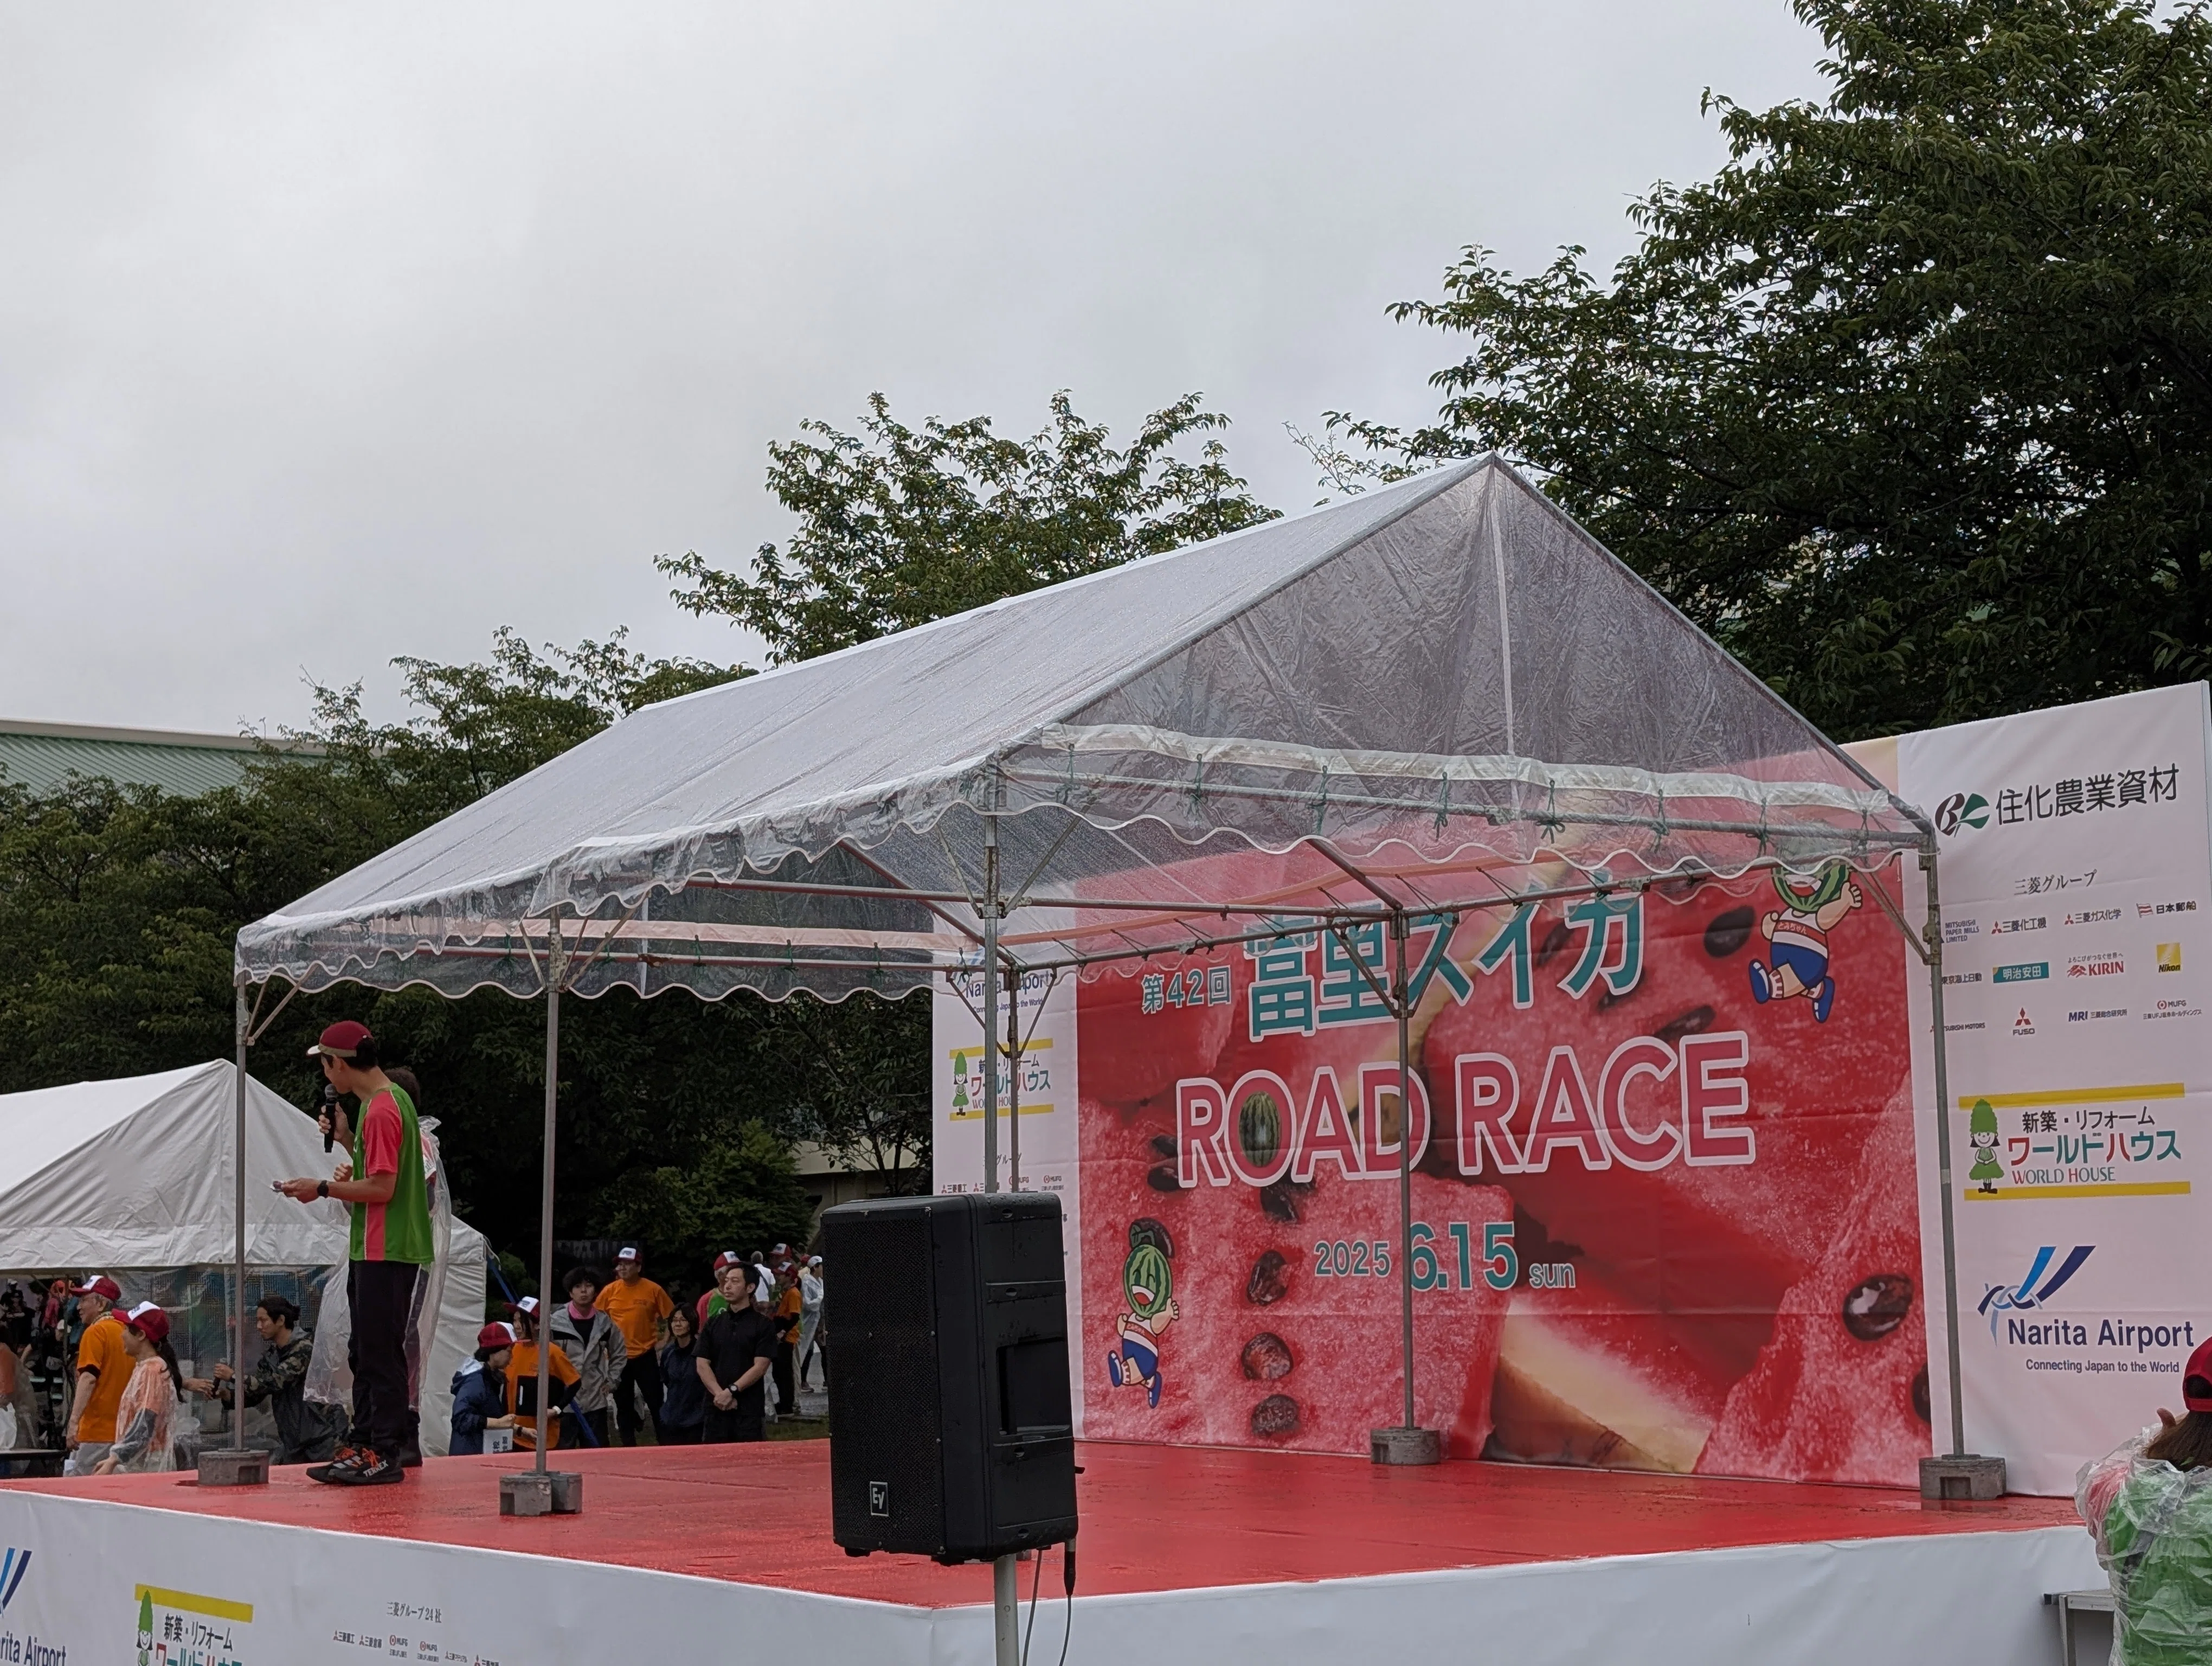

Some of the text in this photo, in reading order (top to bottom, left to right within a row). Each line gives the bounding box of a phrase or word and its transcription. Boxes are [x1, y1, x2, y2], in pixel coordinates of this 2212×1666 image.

[1996, 763, 2179, 825] 住化農業資材
[2014, 869, 2098, 895] 三菱グループ
[2075, 908, 2121, 923] 三菱ガス化学
[2156, 901, 2196, 914] 日本郵船
[1945, 920, 1976, 928] MITSUBISHI
[2003, 918, 2047, 933] 三菱化工機
[1946, 935, 1968, 943] LIMITED
[2068, 952, 2124, 963] よろこびがつなぐ世界へ
[2003, 966, 2042, 979] 明治安田
[2088, 961, 2124, 976] KIRIN
[2158, 964, 2181, 973] Nikon
[1141, 965, 1231, 1014] 第42回
[2068, 1011, 2088, 1022] MRI
[1176, 1030, 1756, 1188] ROAD RACE
[2022, 1106, 2155, 1133] 新築・リフォーム
[2008, 1131, 2181, 1166] ワールドハウス
[2012, 1167, 2116, 1184] WORLD HOUSE
[1314, 1221, 1576, 1291] 2025 6.15 sun
[2008, 1318, 2194, 1353] Narita Airport
[2026, 1359, 2179, 1374] Connecting Japan to the World
[387, 1601, 442, 1623] 三菱グループ24社
[164, 1613, 233, 1652] 新築・リフォーム
[24, 1636, 66, 1666] Airport
